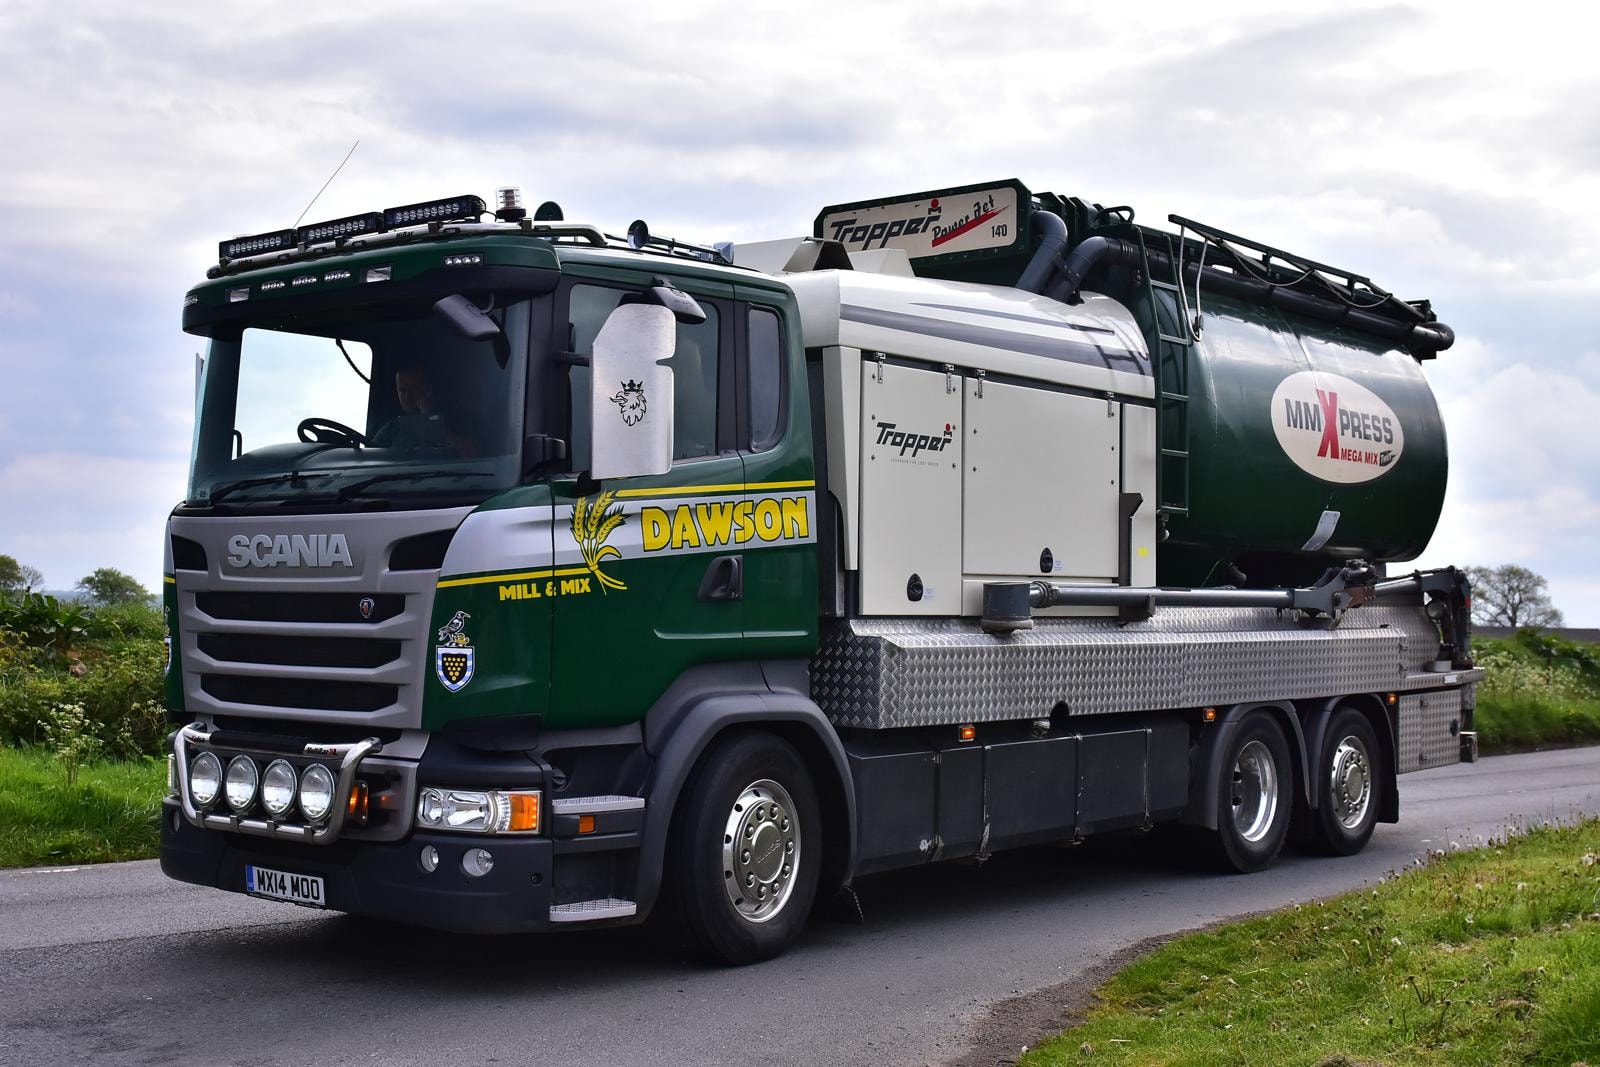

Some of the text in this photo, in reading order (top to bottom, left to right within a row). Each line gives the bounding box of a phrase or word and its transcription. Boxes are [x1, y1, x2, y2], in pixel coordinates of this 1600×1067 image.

[931, 216, 971, 241] Power
[991, 223, 1008, 239] 140
[1340, 447, 1379, 466] MEGA MIX
[641, 495, 810, 553] DAWSON
[227, 533, 354, 569] SCANIA
[499, 577, 592, 601] MILL & MIX
[257, 869, 321, 901] MX14 MOO
